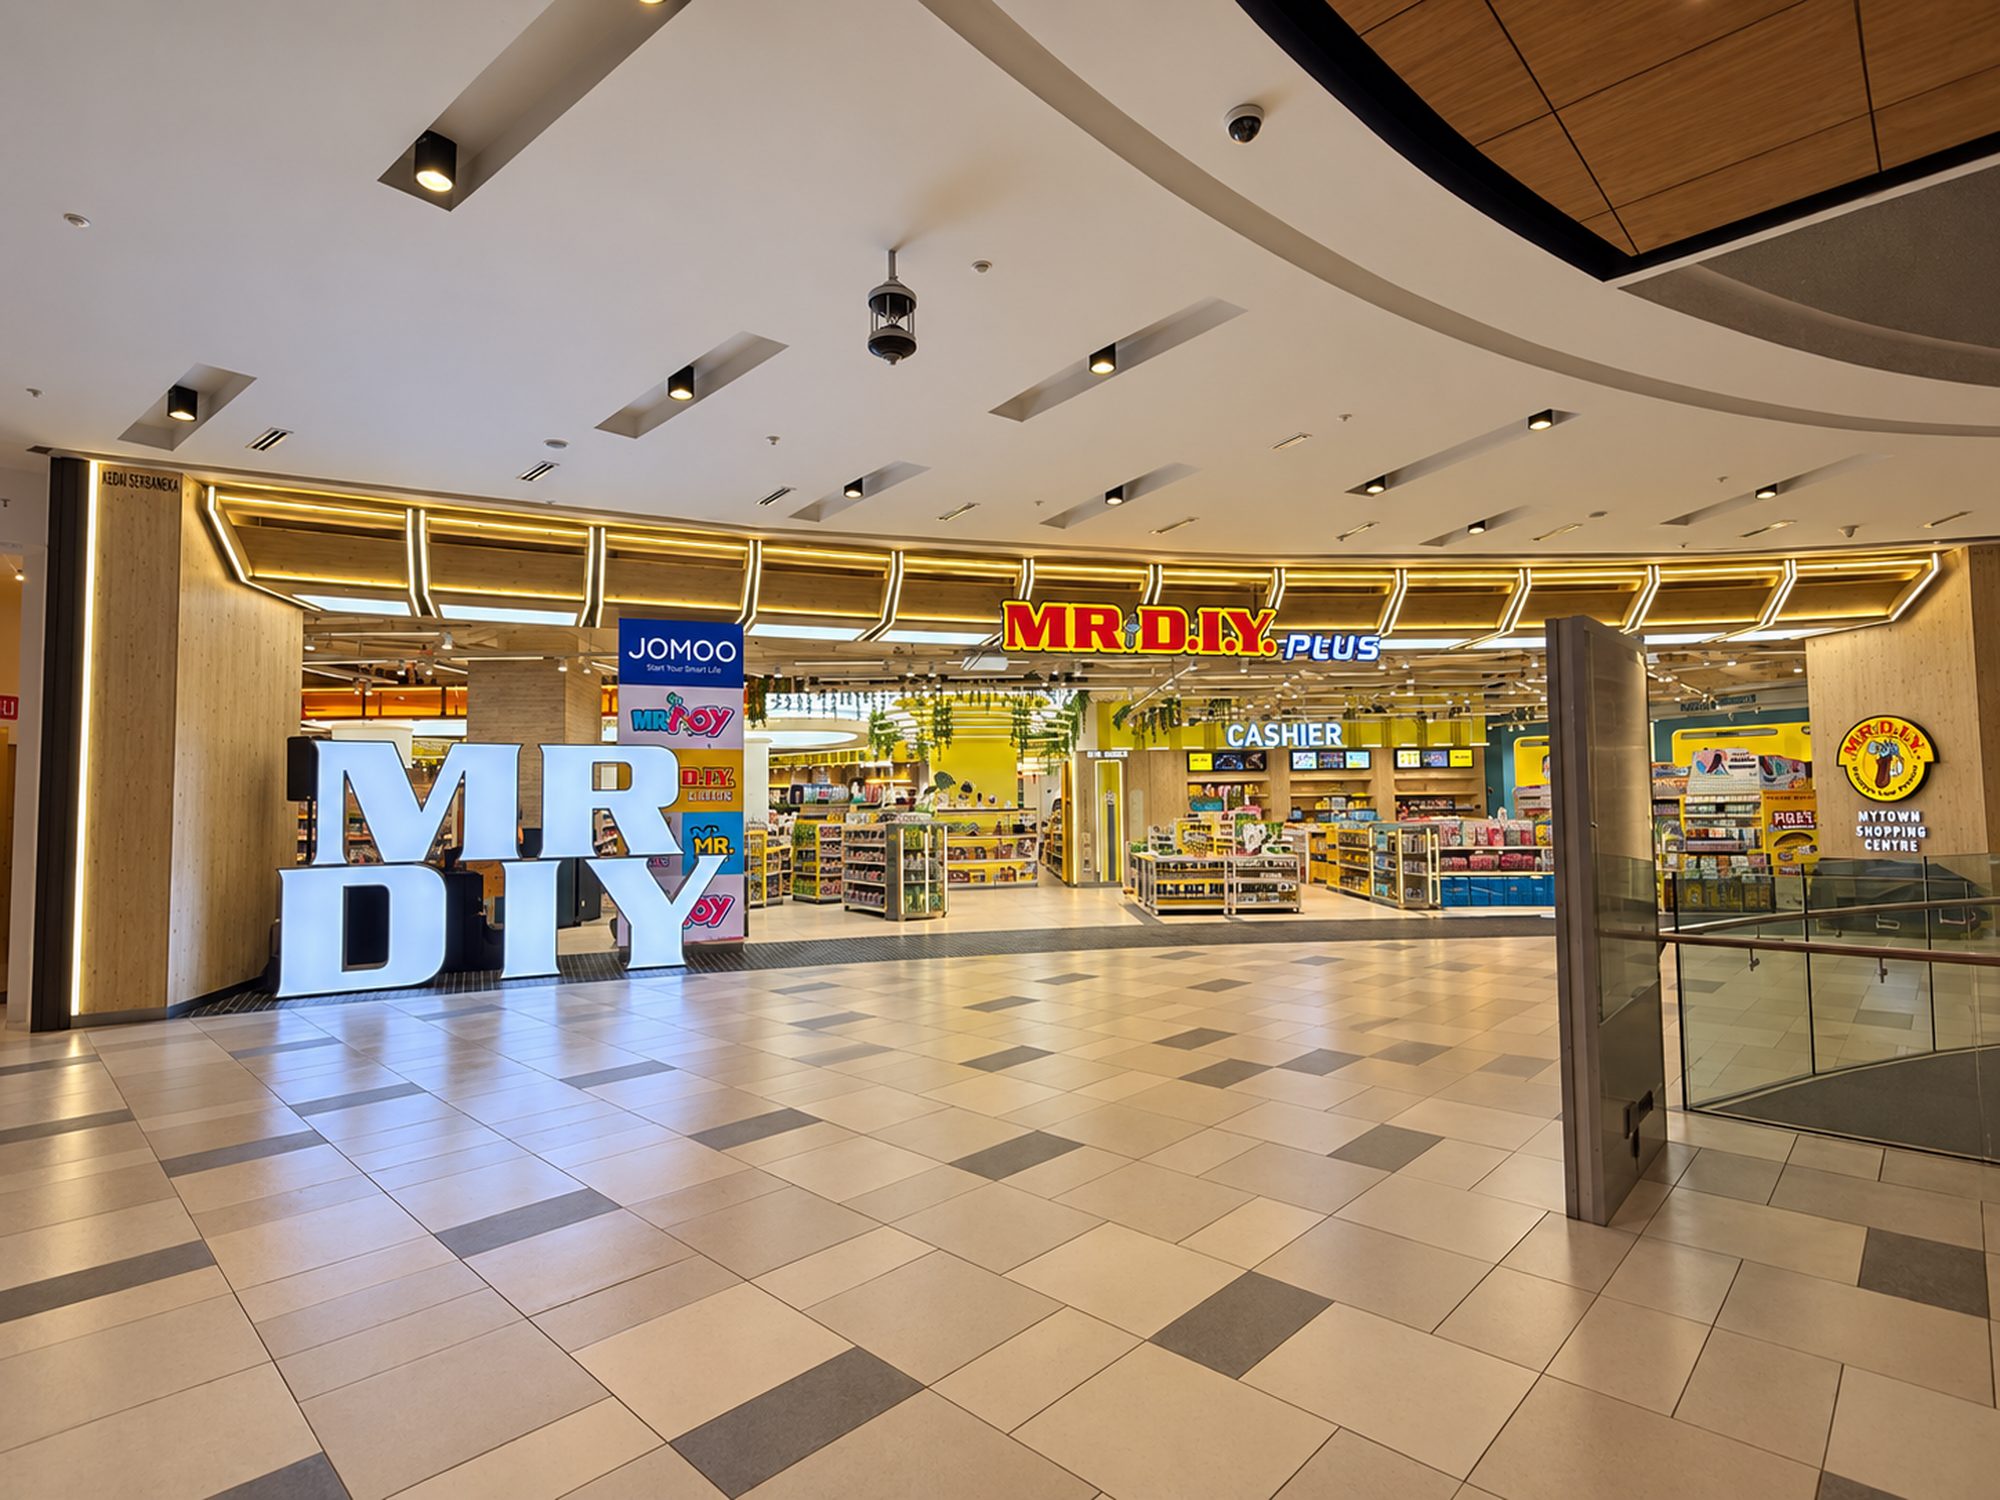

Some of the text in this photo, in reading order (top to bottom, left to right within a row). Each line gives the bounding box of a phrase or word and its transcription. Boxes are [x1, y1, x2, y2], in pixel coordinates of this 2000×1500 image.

[628, 637, 737, 663] JOMOO
[1282, 633, 1382, 661] PLUS
[646, 663, 722, 674] Start Your Smart Life
[1225, 721, 1344, 748] CASHIER
[312, 740, 684, 866] MR
[1858, 810, 1921, 823] MYTOWN
[1855, 825, 1927, 838] SHOPPING
[1864, 839, 1919, 852] CENTRE
[276, 855, 727, 998] DIY
